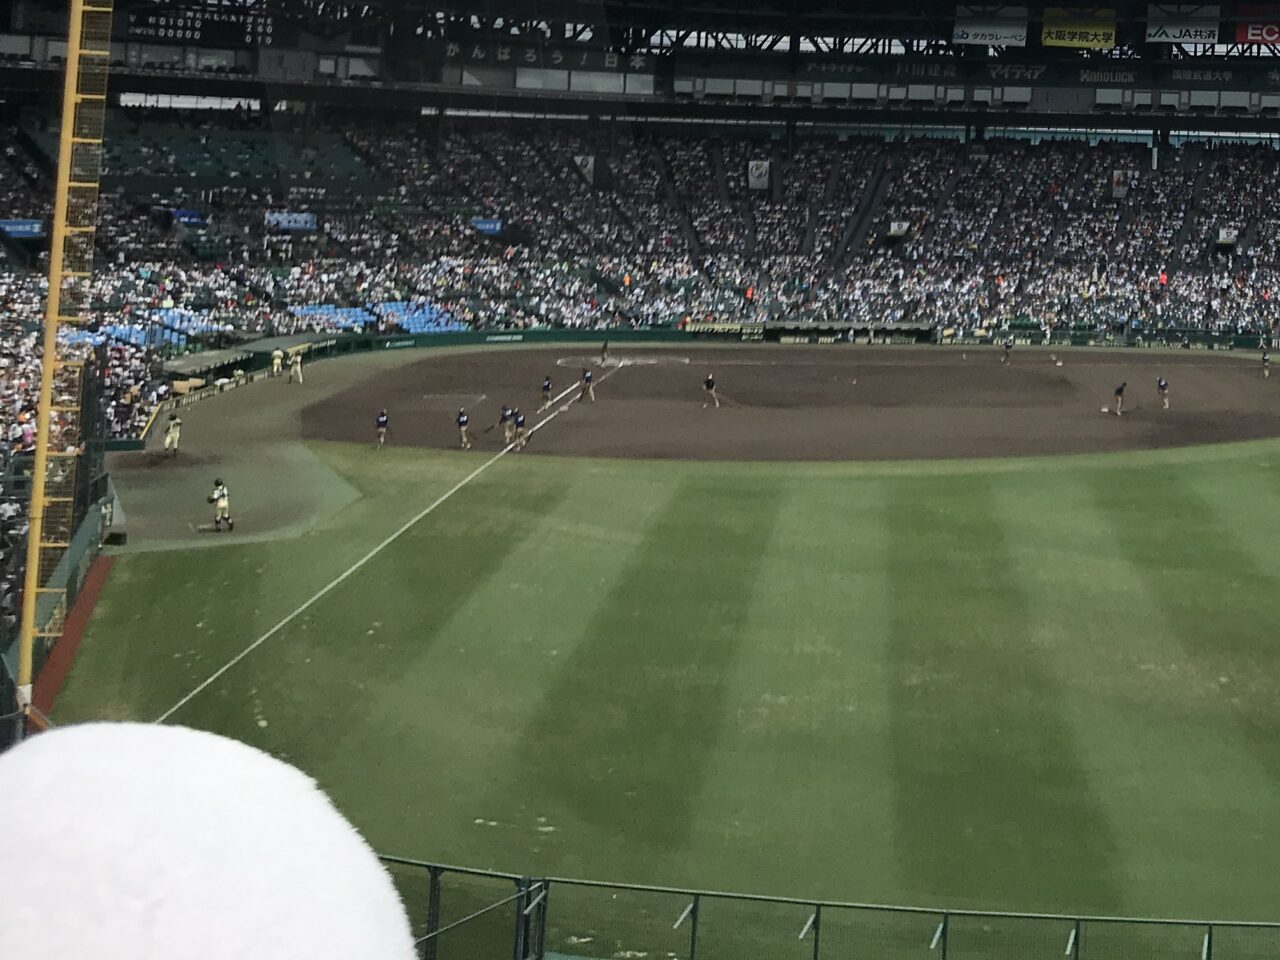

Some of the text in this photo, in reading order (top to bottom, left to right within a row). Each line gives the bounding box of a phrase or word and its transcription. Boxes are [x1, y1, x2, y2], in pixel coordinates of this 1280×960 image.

[1043, 31, 1114, 43] 大阪学院大学
